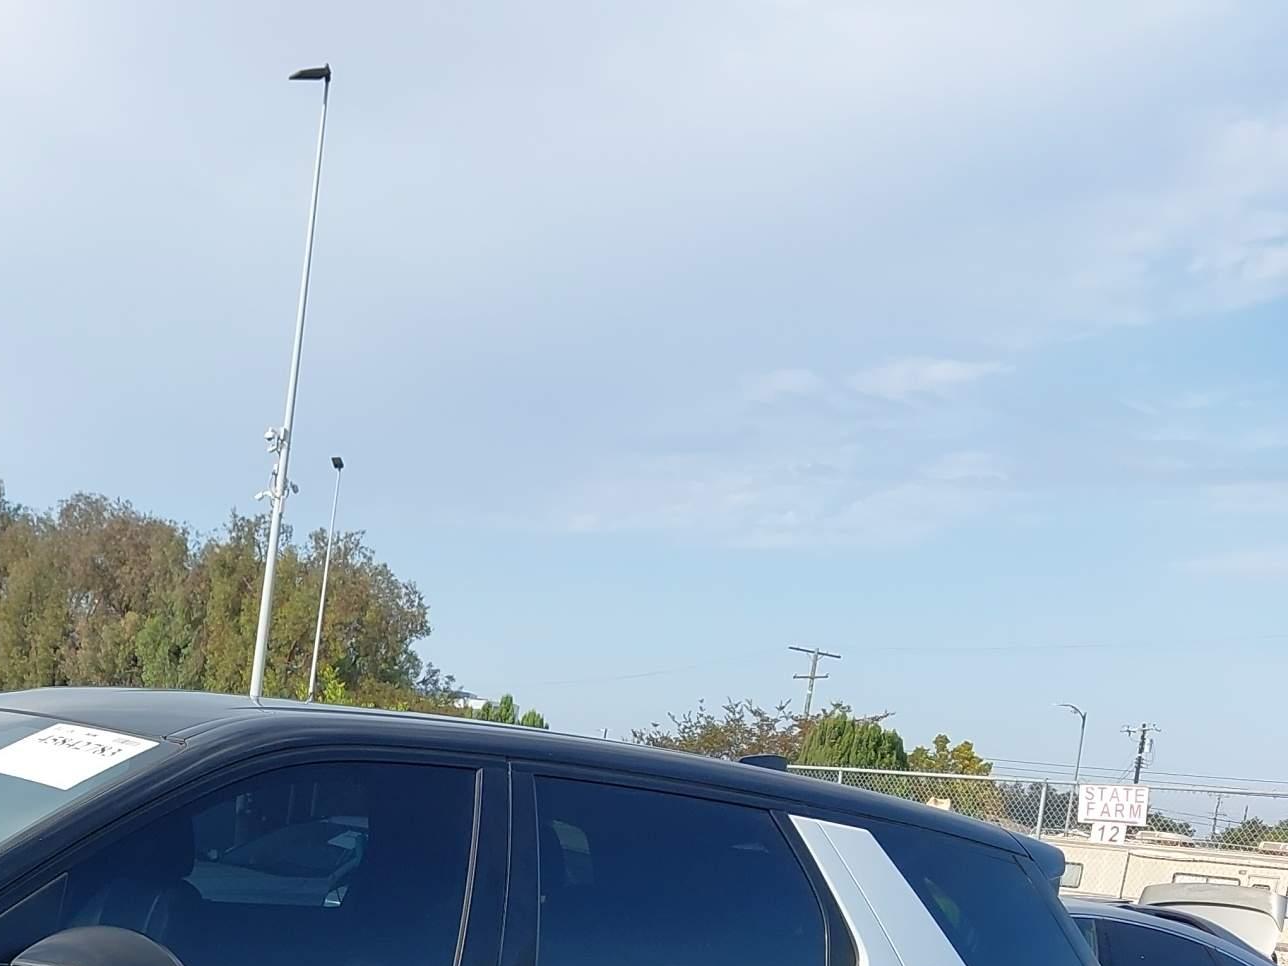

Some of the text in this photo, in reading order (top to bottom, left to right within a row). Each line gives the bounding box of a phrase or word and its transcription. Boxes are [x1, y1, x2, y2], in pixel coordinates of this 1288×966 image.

[1084, 786, 1146, 804] STATE
[1086, 802, 1142, 818] FARM
[1098, 825, 1120, 842] 12
